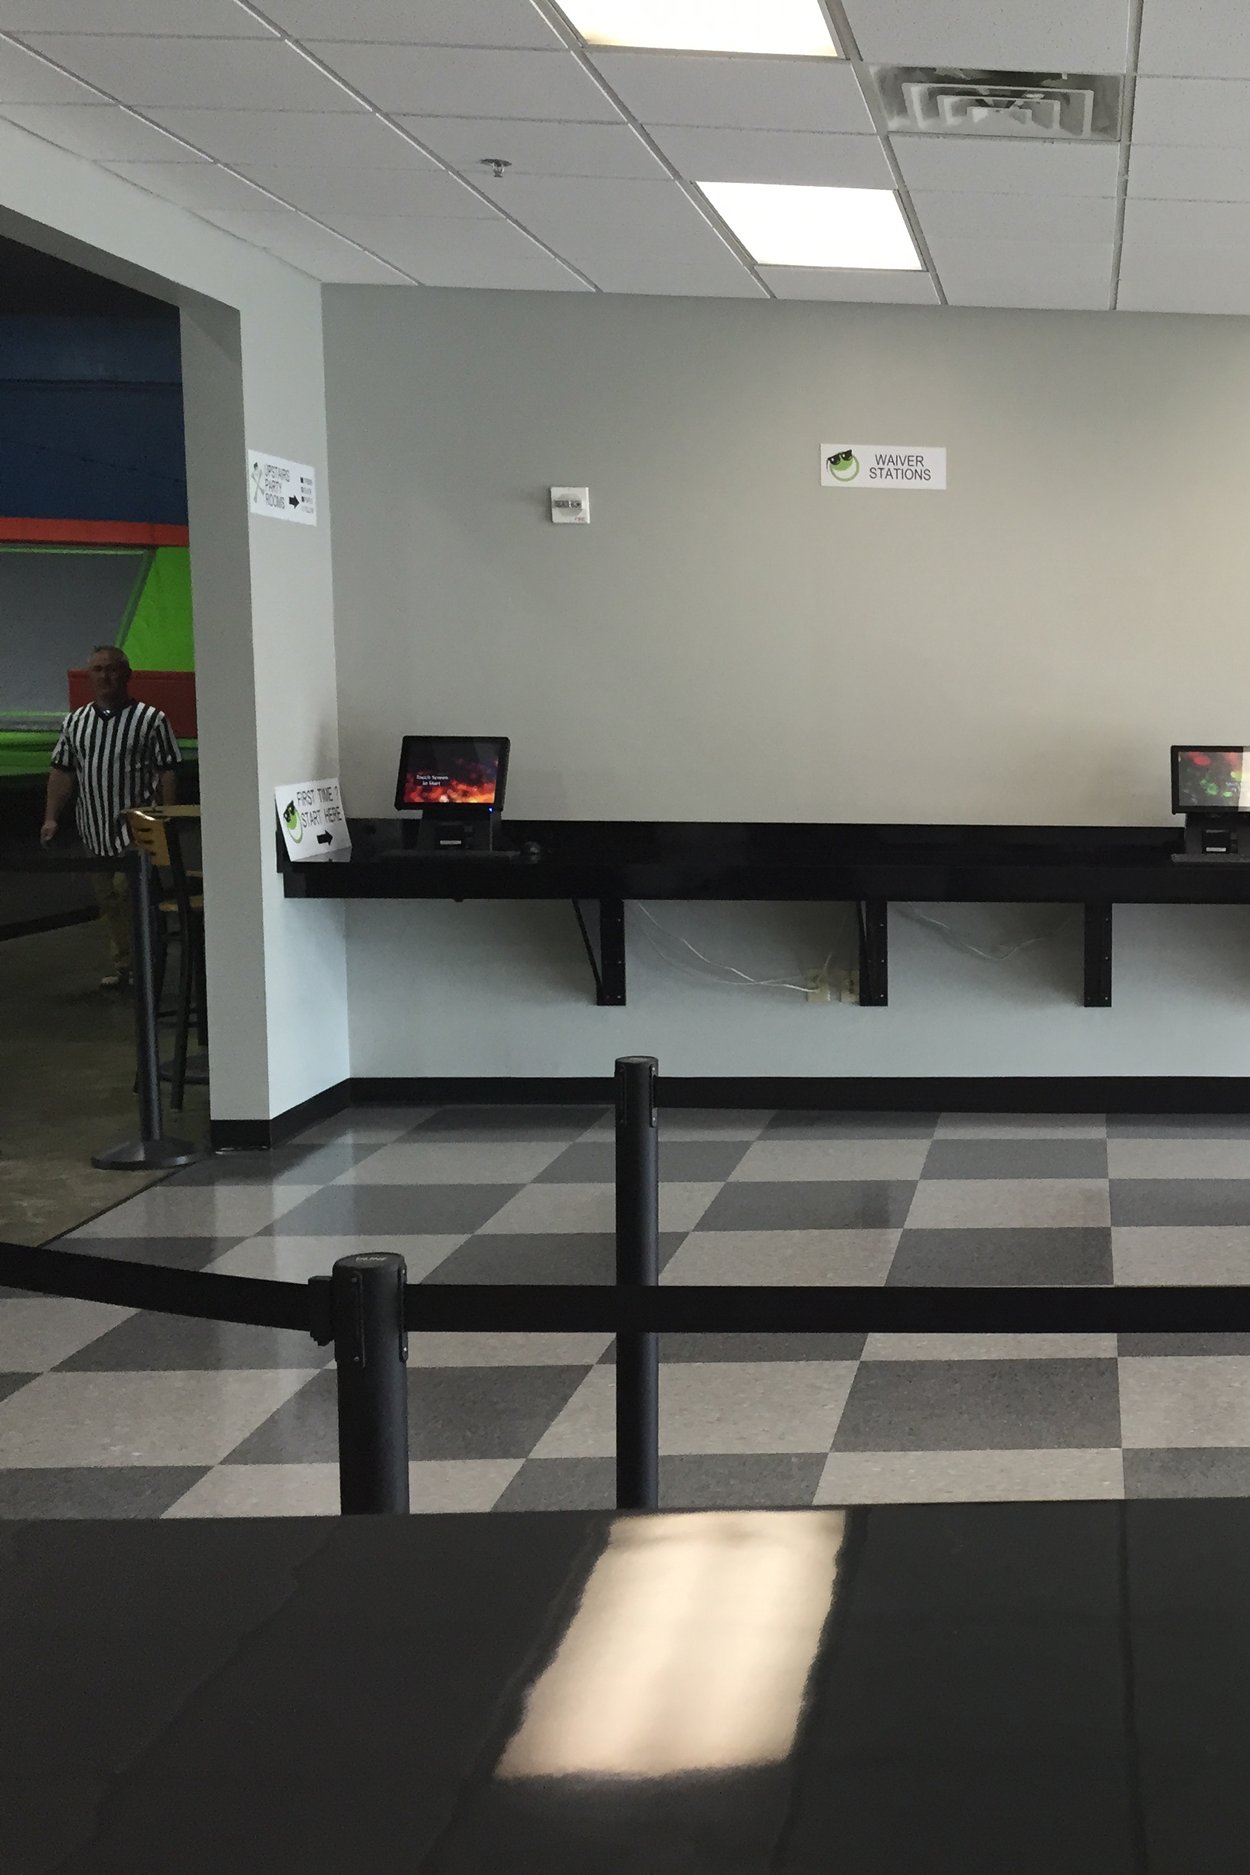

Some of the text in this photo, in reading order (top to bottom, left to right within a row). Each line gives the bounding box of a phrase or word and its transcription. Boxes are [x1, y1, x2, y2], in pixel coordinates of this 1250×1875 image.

[875, 454, 925, 467] WAIVER
[869, 467, 932, 481] STATIONS
[265, 492, 286, 509] ROOMS
[296, 789, 315, 807] FIRST
[317, 786, 334, 803] TIME
[301, 806, 343, 828] START HERE
